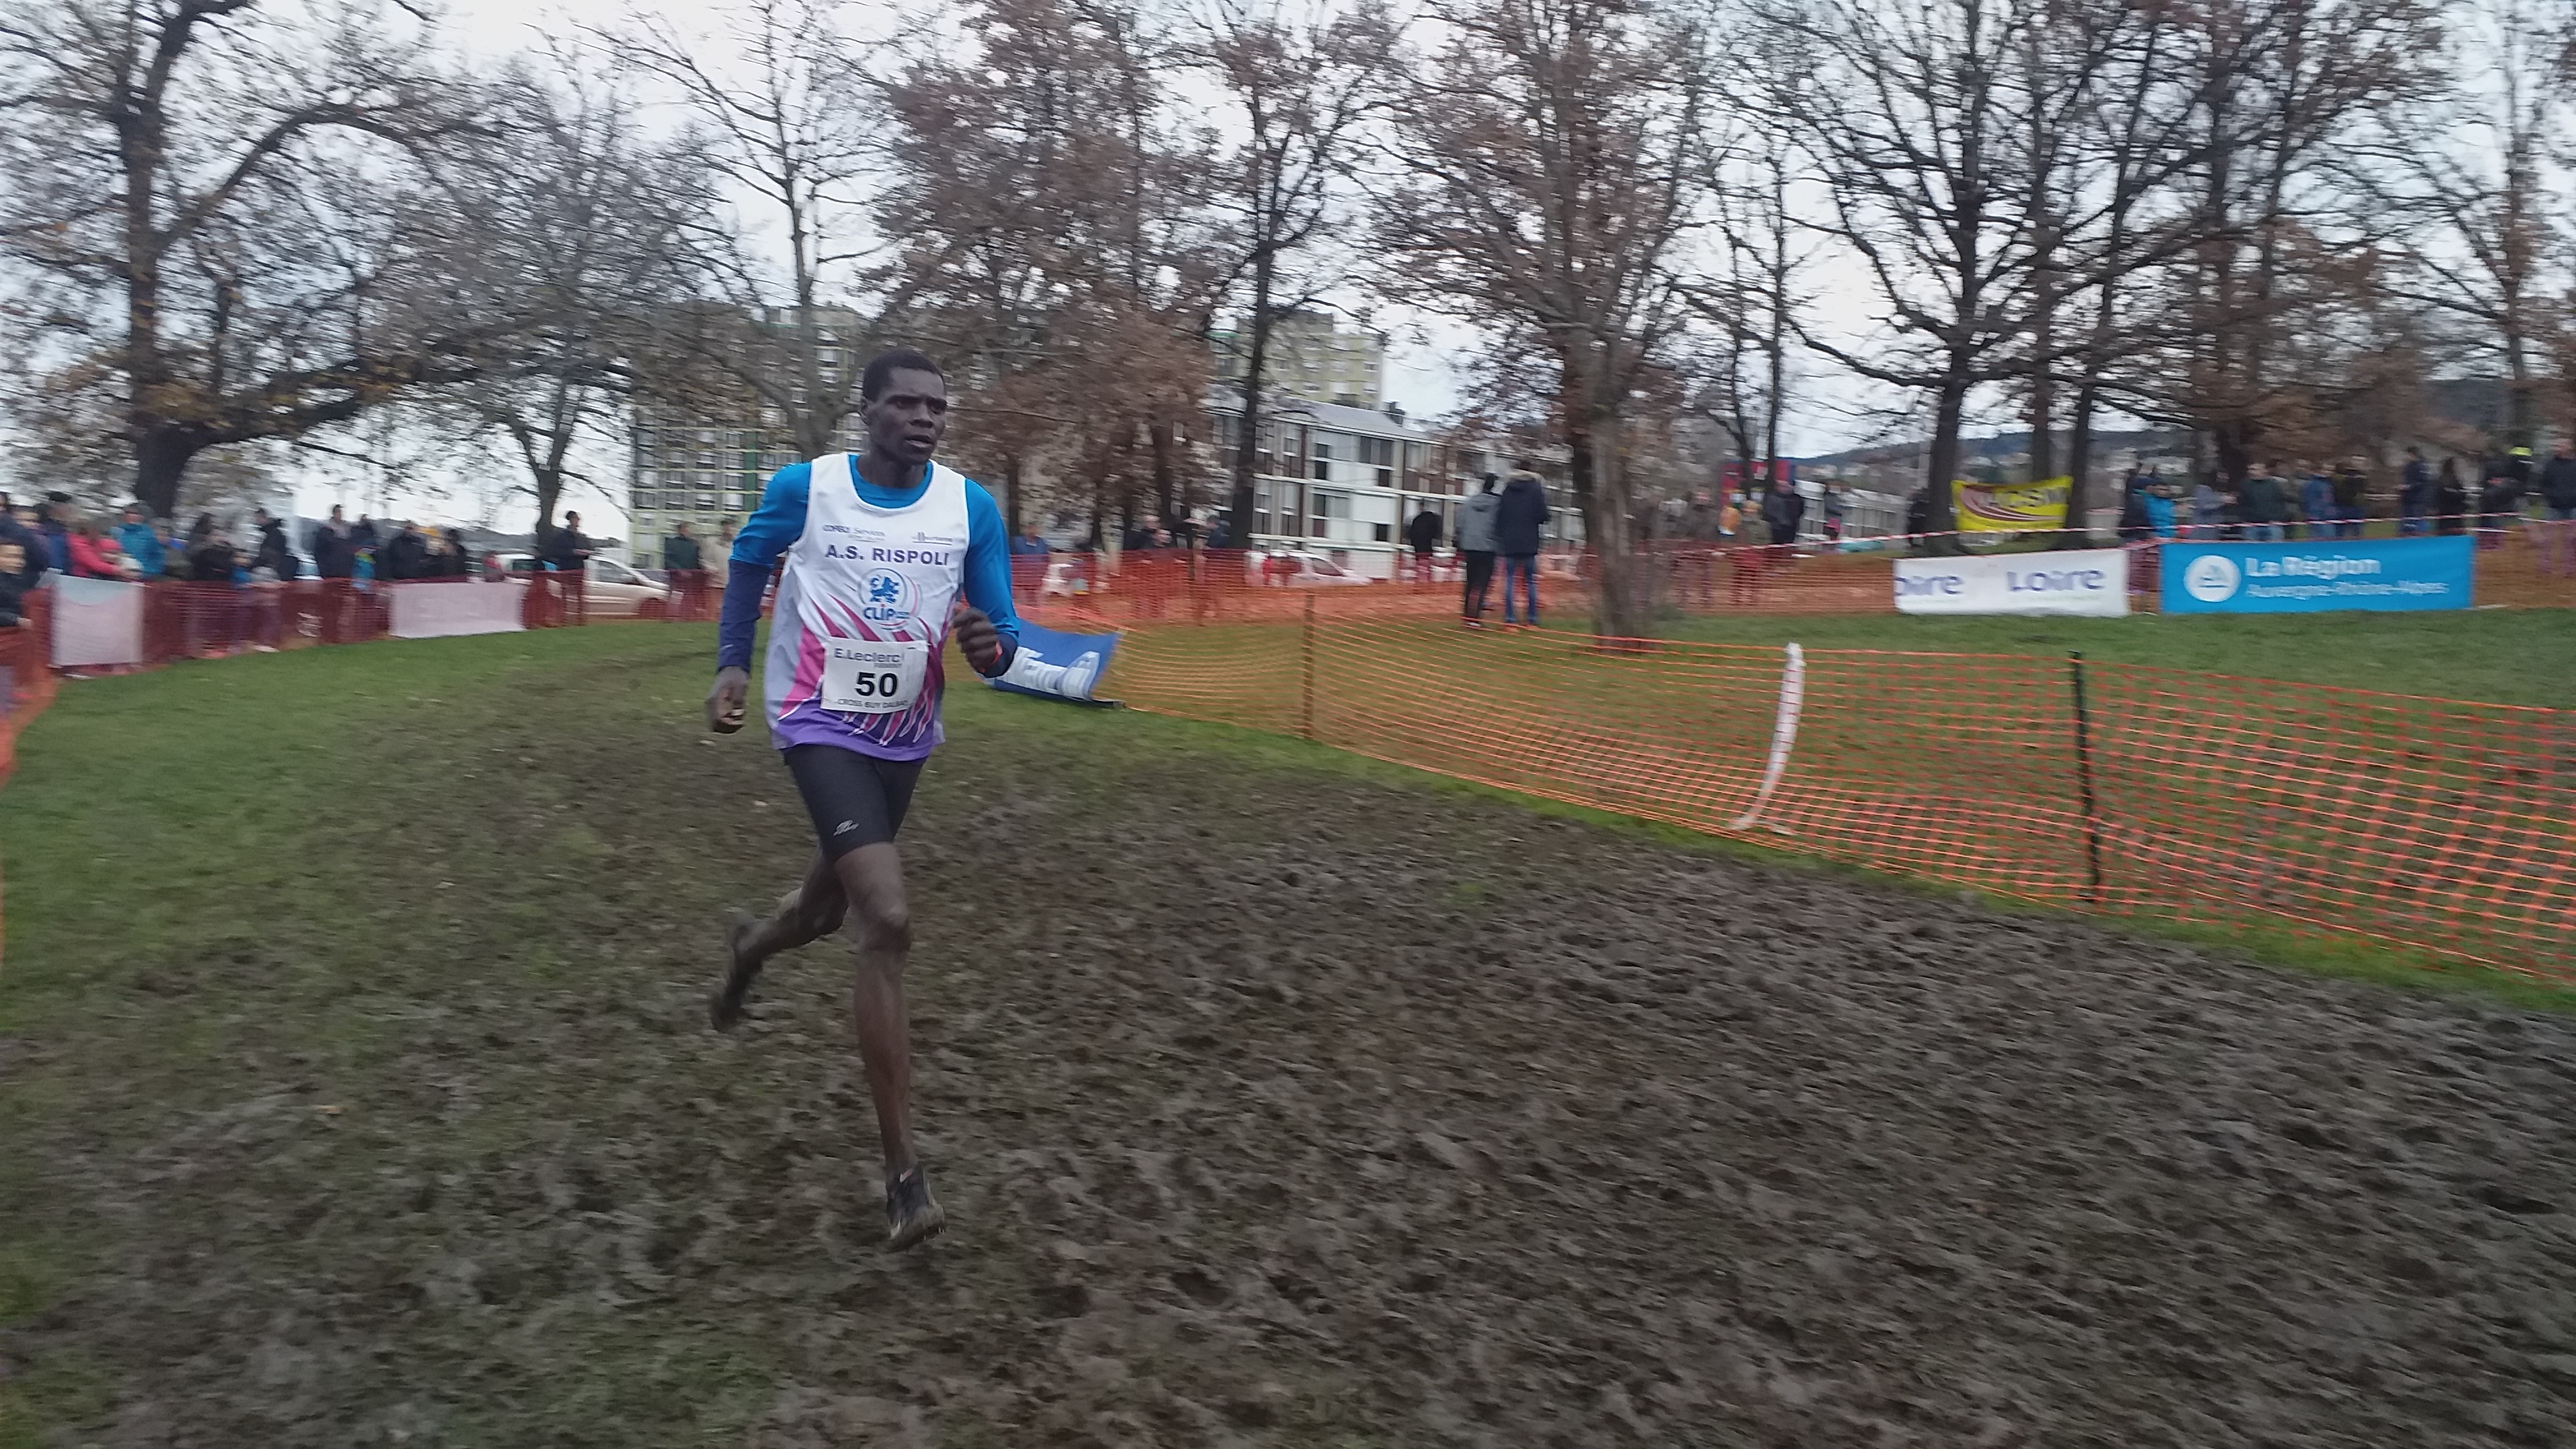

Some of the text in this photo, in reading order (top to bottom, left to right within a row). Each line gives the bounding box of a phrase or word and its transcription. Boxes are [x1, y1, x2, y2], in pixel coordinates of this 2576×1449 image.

[825, 544, 949, 565] A.S. RISPOLI
[2245, 555, 2382, 580] La Région
[834, 648, 901, 663] E.Leclerc
[855, 671, 898, 698] 50
